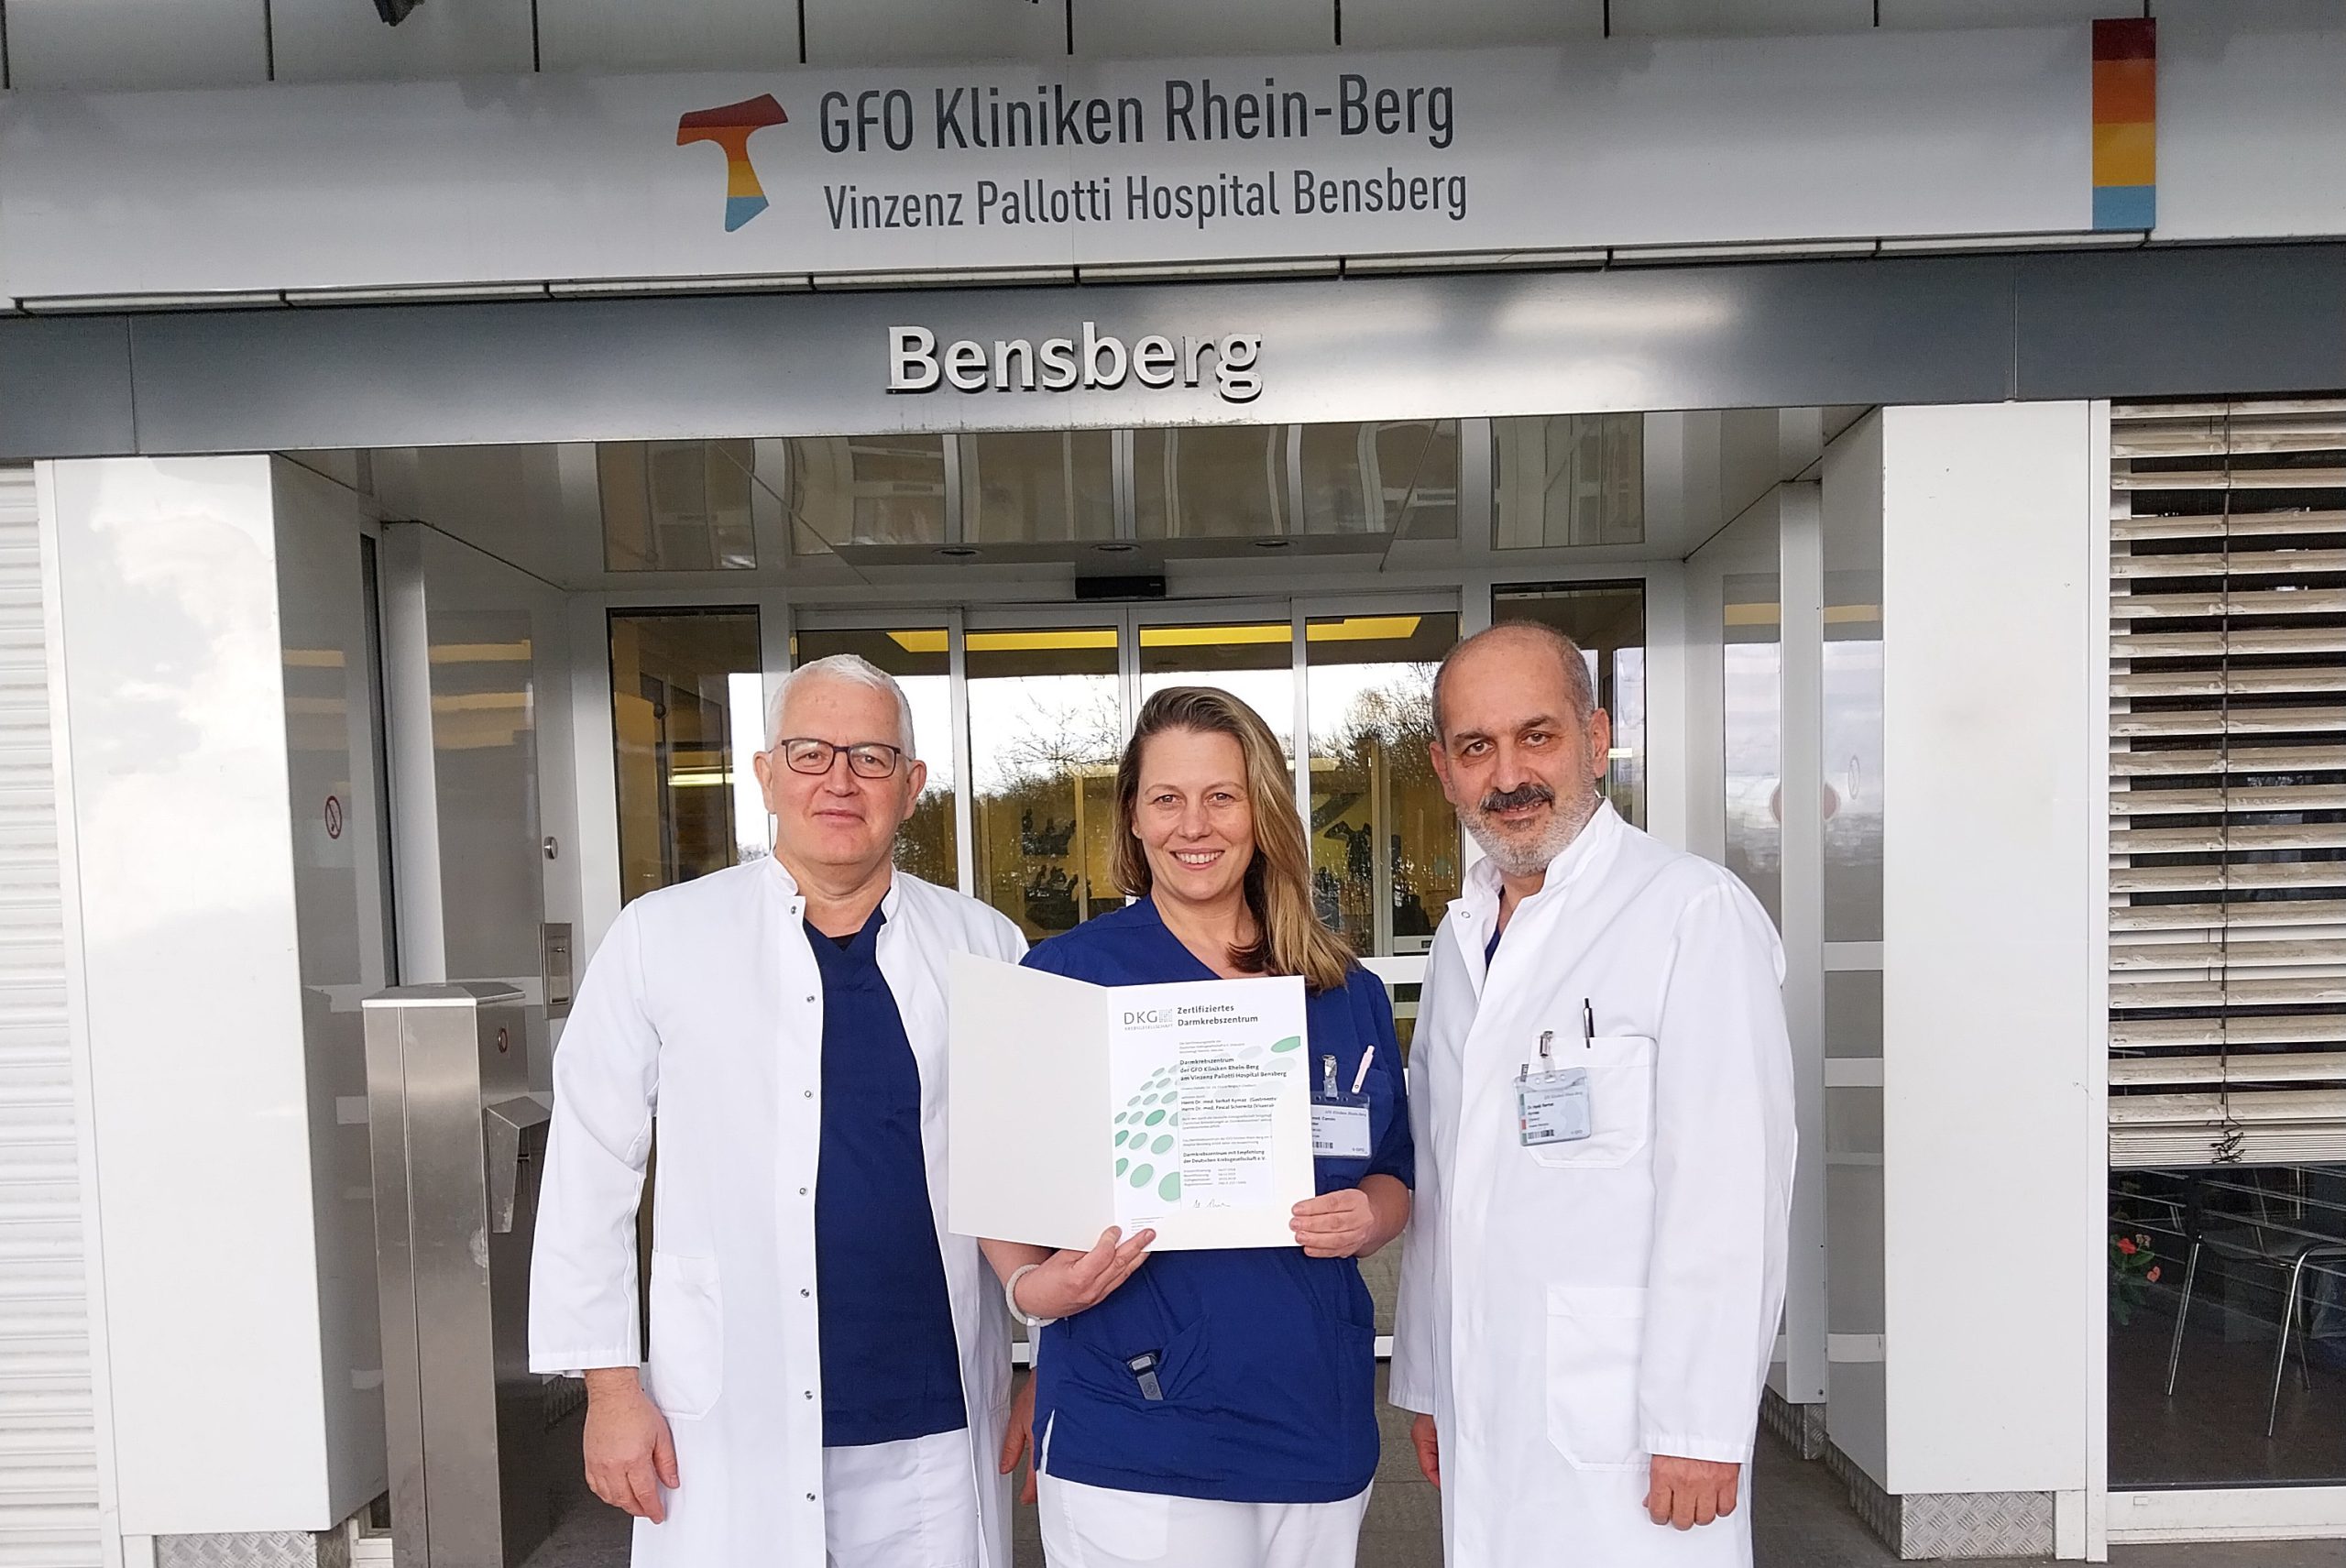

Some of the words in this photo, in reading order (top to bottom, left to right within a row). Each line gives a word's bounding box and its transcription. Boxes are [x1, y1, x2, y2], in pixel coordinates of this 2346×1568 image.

[819, 91, 915, 154] GFO
[935, 83, 1146, 150] Kliniken
[1164, 73, 1456, 149] Rhein-Berg
[824, 184, 965, 231] Vinzenz
[976, 176, 1113, 227] Pallotti
[1125, 171, 1279, 229] Hospital
[1293, 167, 1469, 222] Bensberg
[887, 321, 1265, 403] Bensberg
[1177, 1004, 1234, 1014] Zertifiziertes
[1124, 1010, 1157, 1025] DKG
[1178, 1015, 1258, 1026] Darmkrebszentrum
[1179, 1058, 1234, 1066] Darmkrebszentrum
